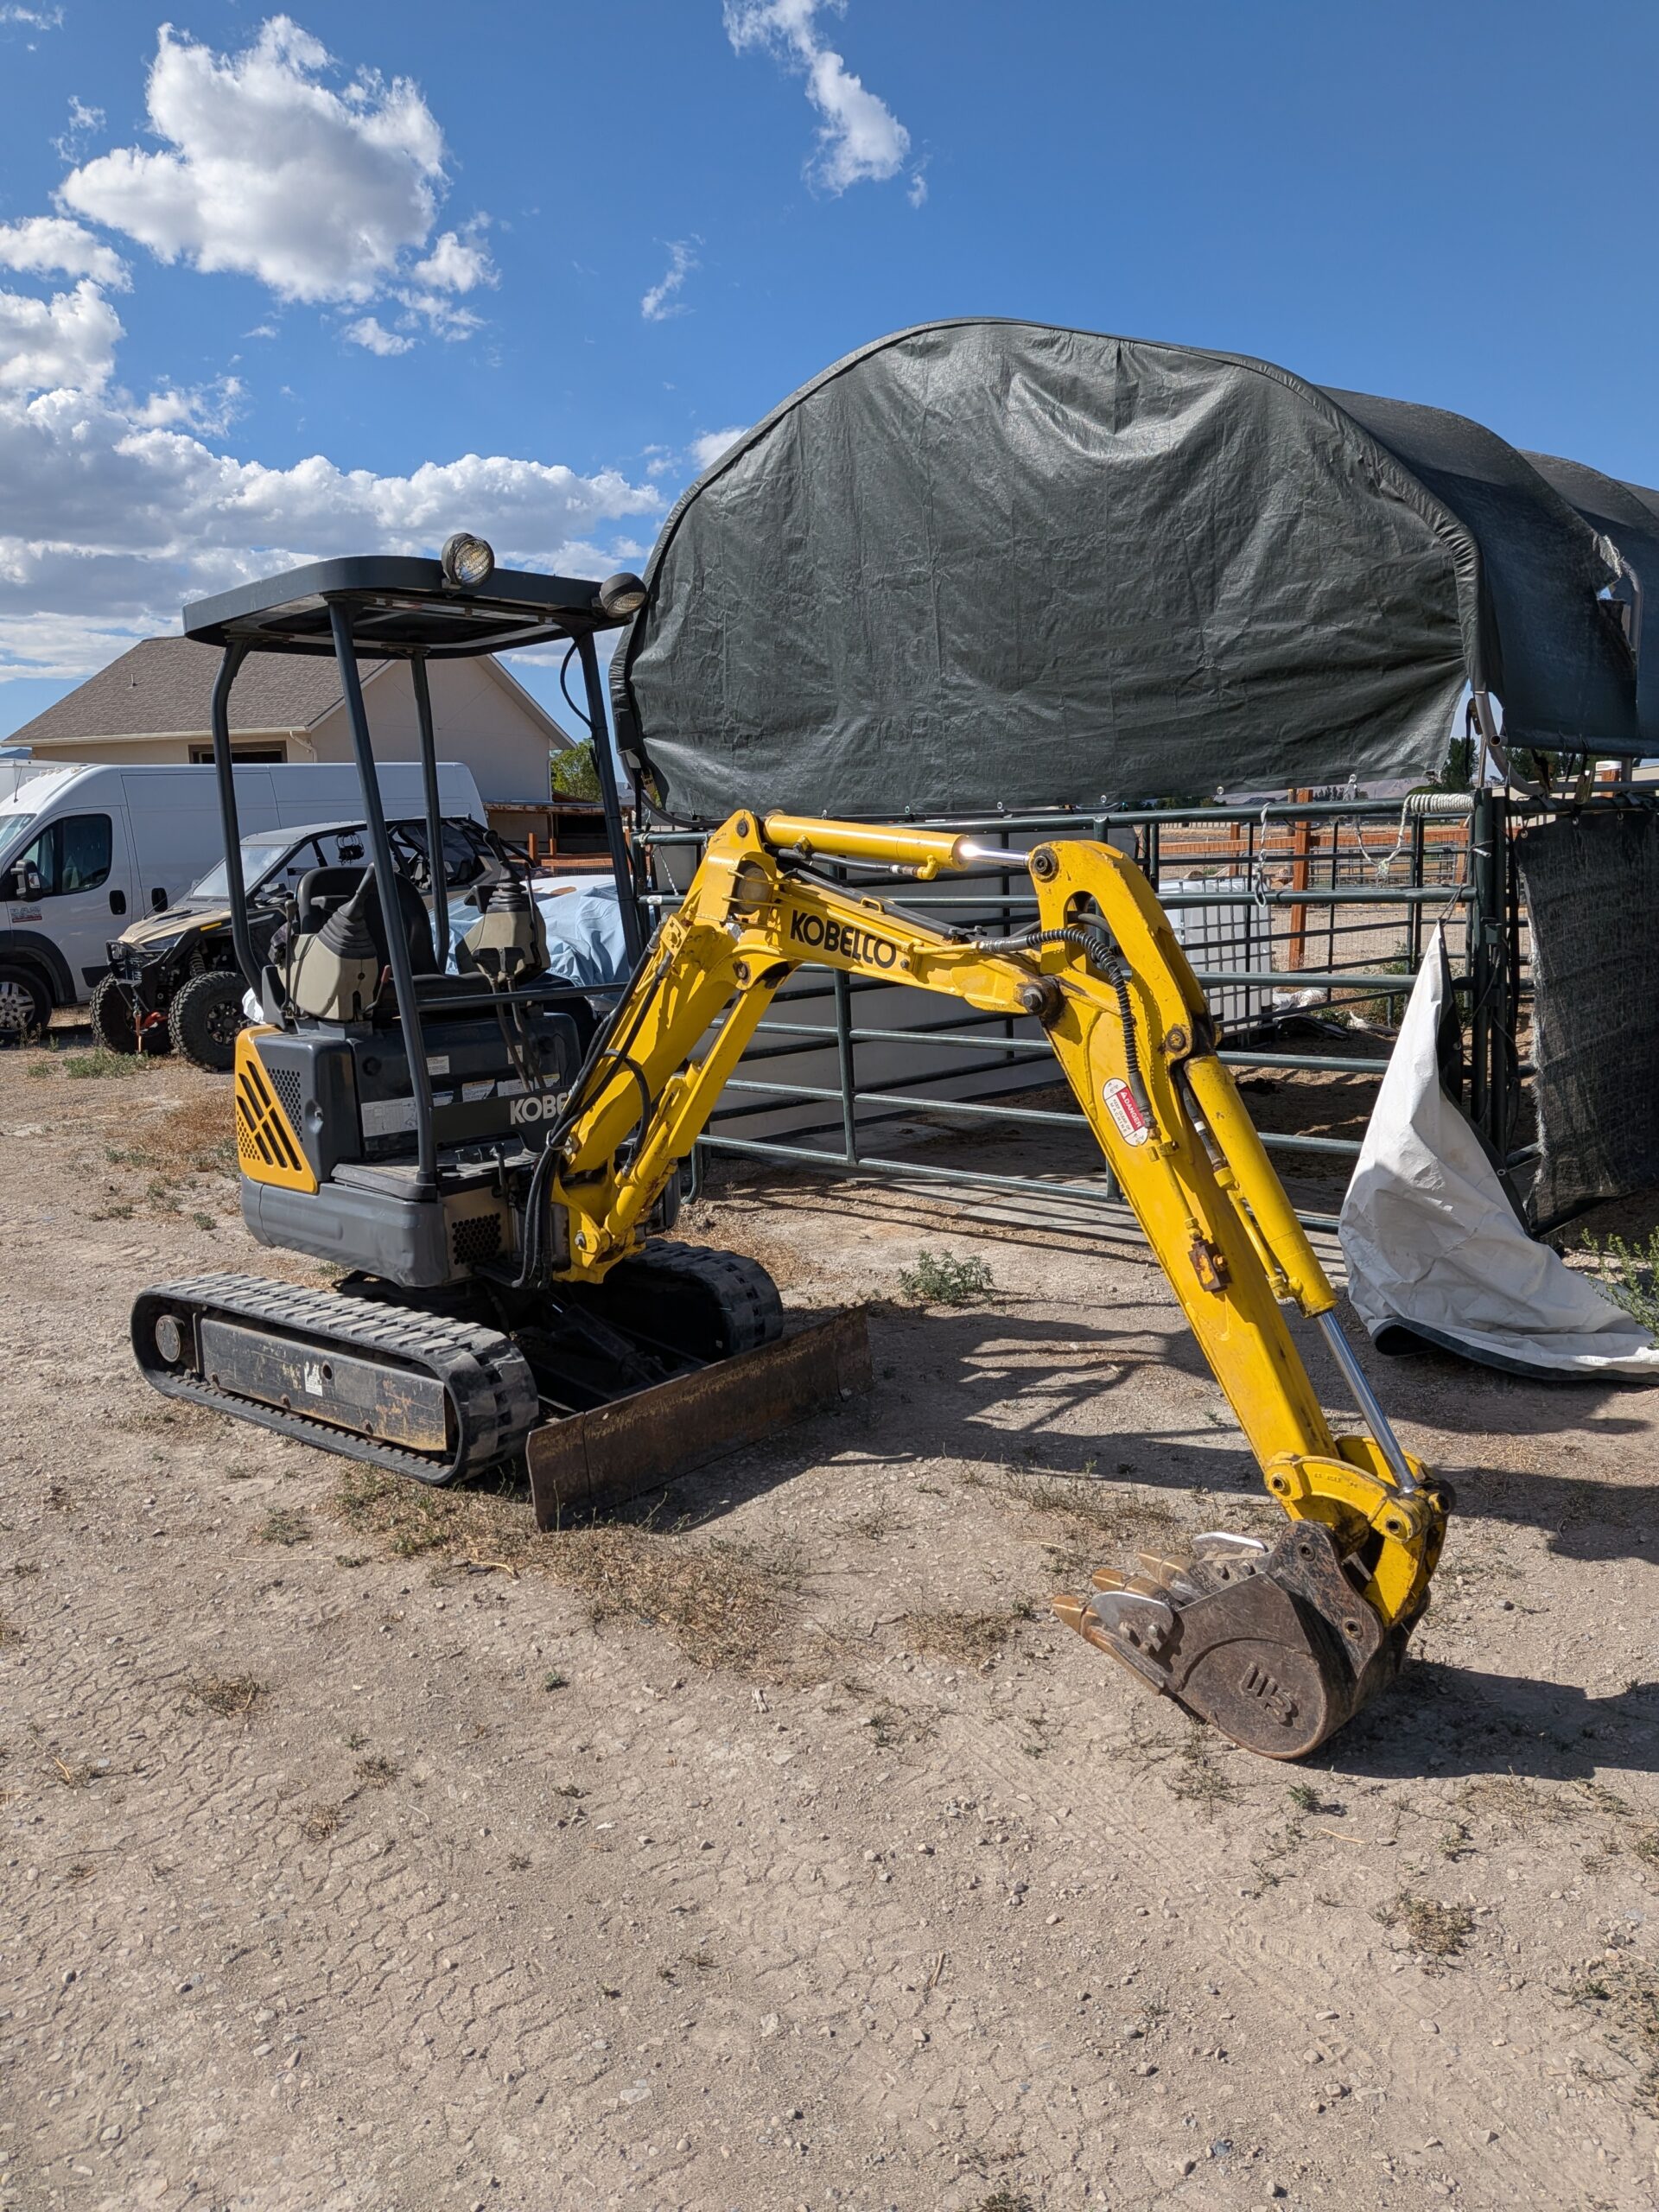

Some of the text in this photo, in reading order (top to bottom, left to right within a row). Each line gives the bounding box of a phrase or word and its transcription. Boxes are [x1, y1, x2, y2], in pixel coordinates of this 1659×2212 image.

[790, 910, 897, 969] KOBELCO
[1110, 1102, 1128, 1132] MACHINE
[1112, 1098, 1121, 1109] KEEP
[1119, 1110, 1128, 1123] CLEAR
[1124, 1098, 1142, 1128] DANGER
